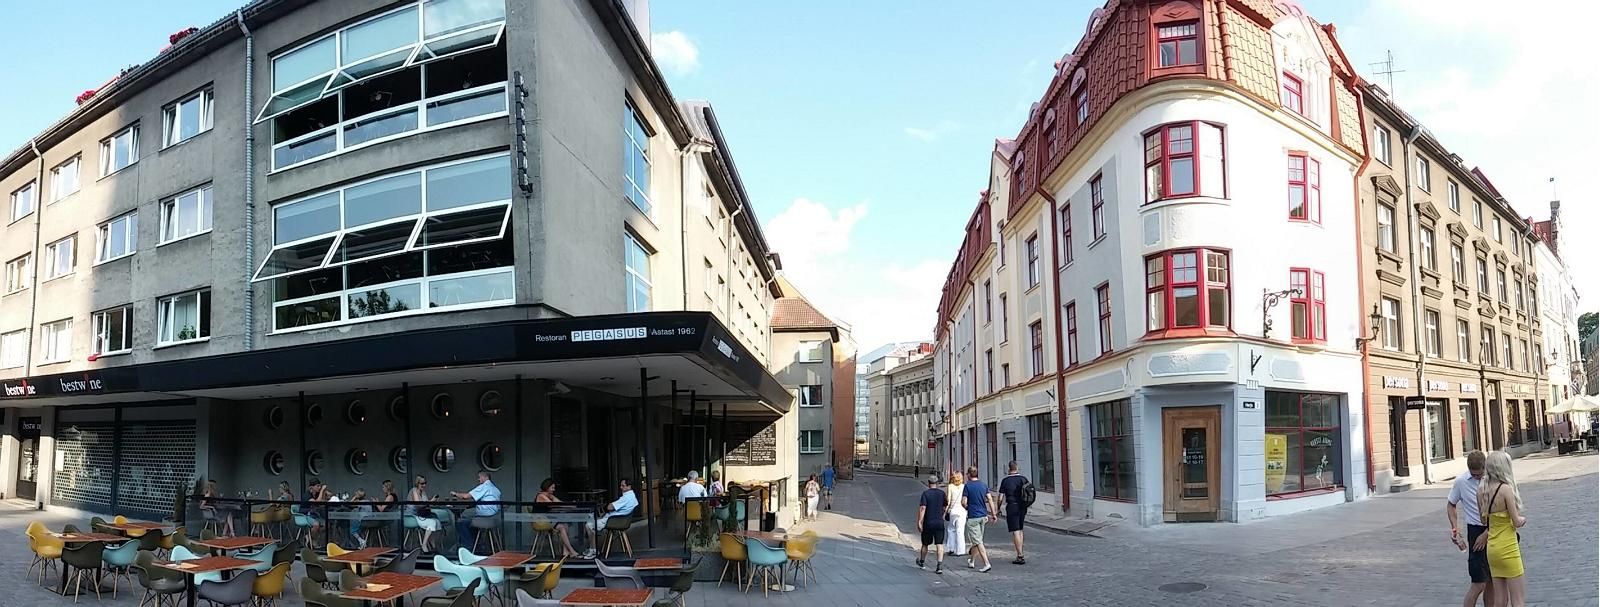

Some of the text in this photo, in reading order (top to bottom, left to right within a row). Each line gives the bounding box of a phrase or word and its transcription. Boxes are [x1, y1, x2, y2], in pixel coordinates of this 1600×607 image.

[535, 334, 567, 342] Restoran
[572, 327, 647, 341] PEGASUS
[677, 327, 696, 335] 1962
